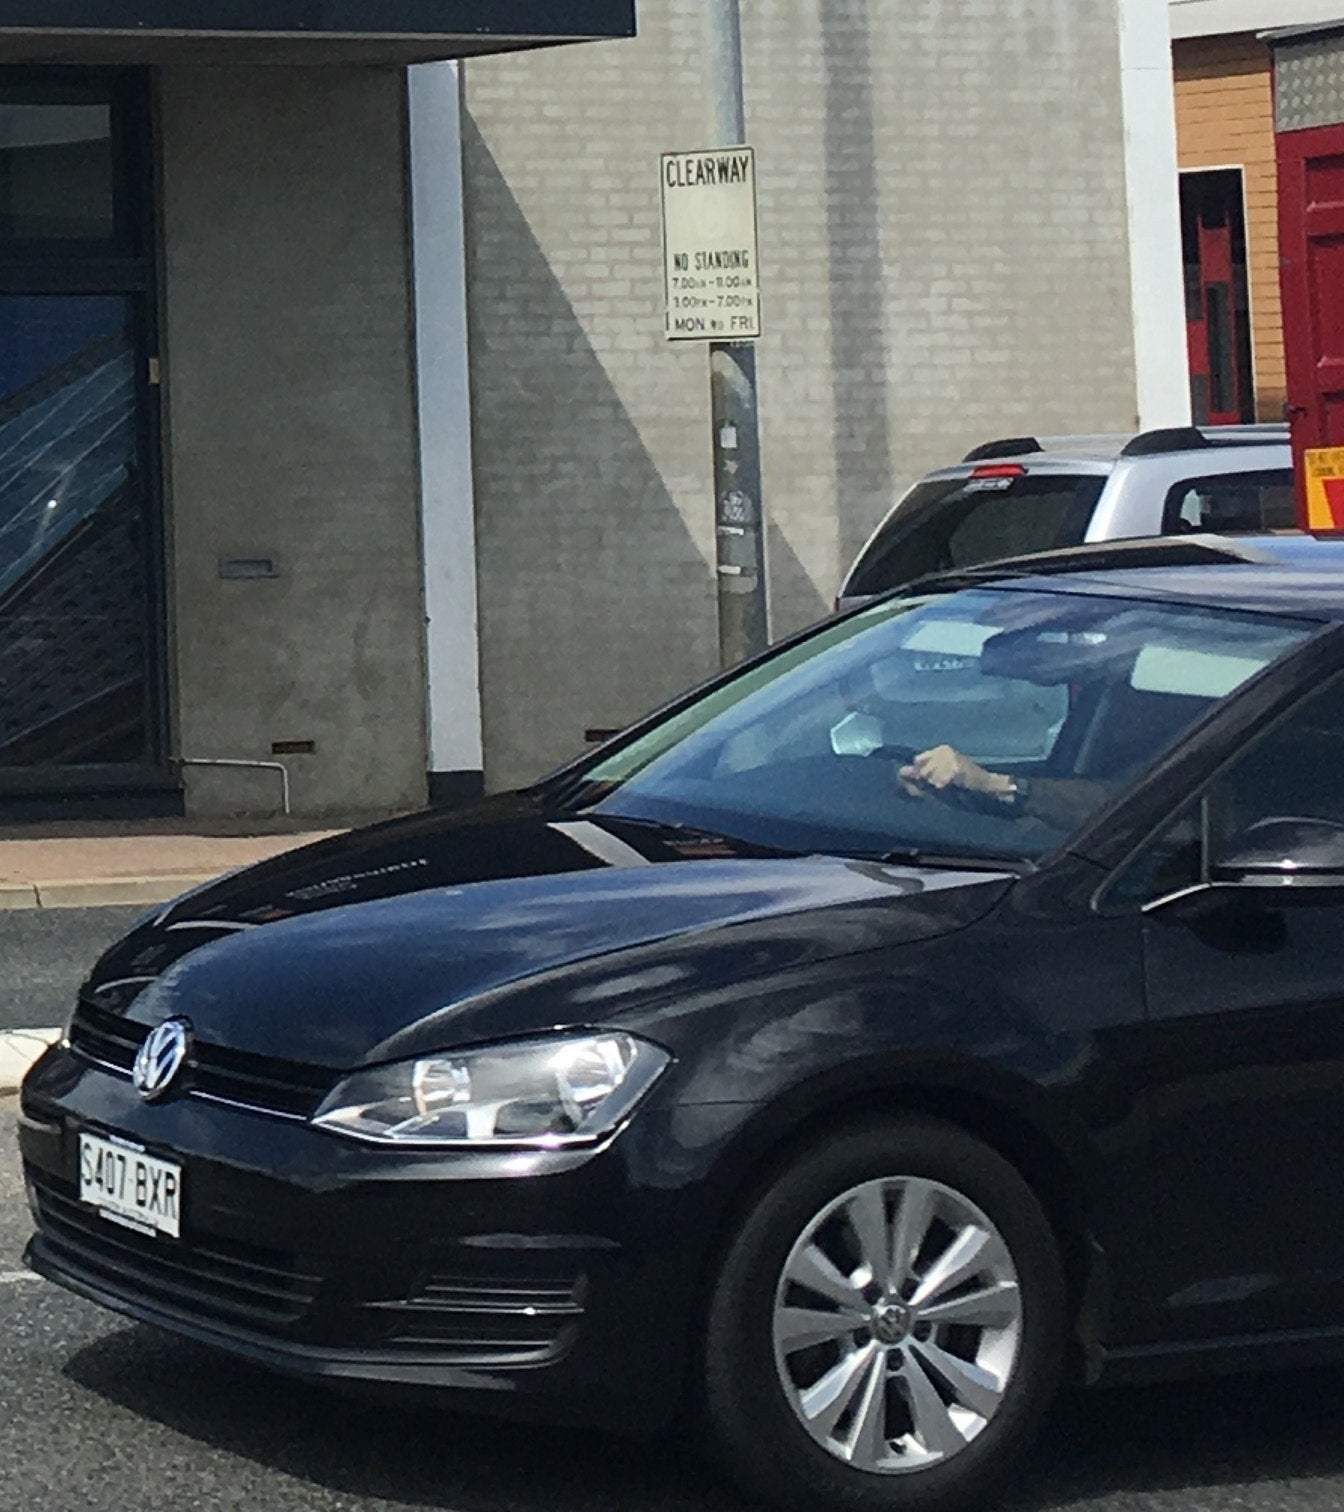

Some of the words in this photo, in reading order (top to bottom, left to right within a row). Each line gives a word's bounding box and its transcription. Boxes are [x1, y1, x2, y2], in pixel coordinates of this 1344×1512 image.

[666, 155, 749, 188] CLEARWAY
[673, 251, 689, 272] NO
[694, 249, 749, 271] STANDING
[675, 318, 705, 332] MON
[731, 316, 754, 330] FRI
[83, 1143, 128, 1200] S407
[135, 1160, 178, 1220] BXR
